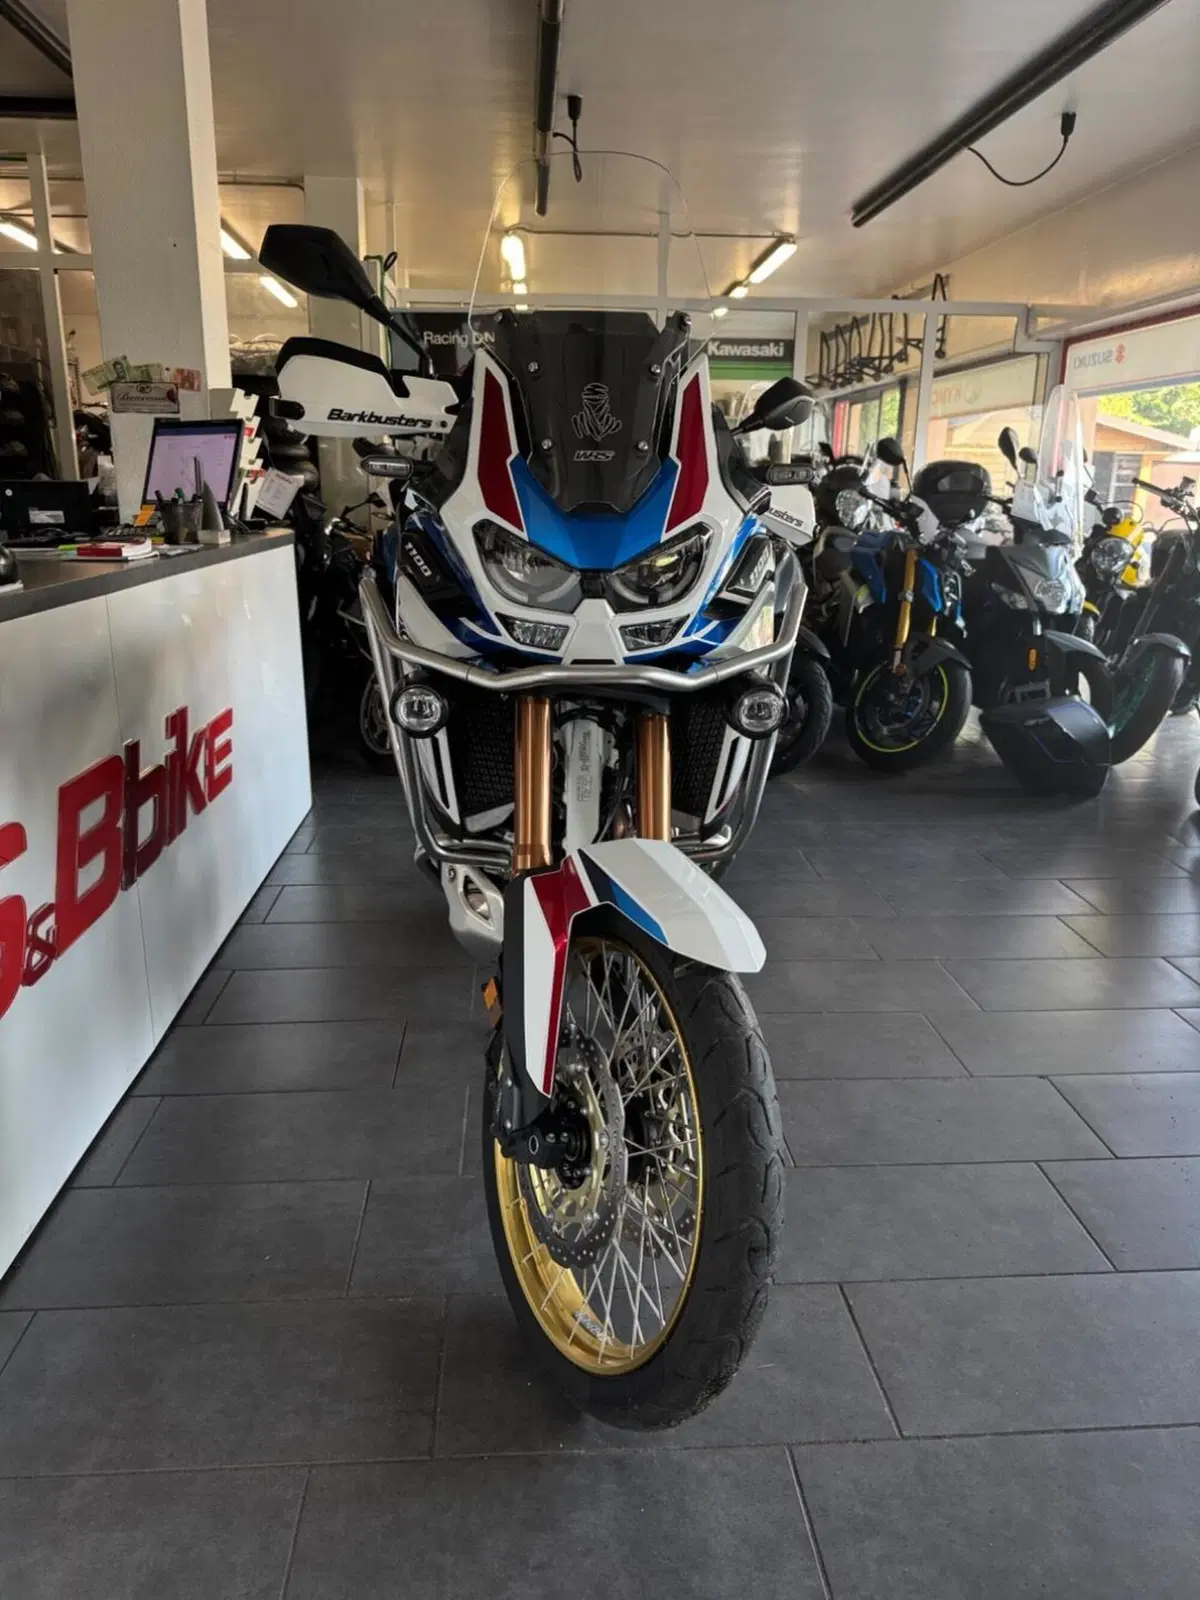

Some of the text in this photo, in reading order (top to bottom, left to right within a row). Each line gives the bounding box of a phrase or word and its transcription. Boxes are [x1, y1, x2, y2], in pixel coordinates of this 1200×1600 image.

[423, 331, 469, 348] Racing
[708, 341, 785, 357] Kawasaki
[327, 408, 433, 429] Barkbusters
[768, 508, 804, 527] usters
[405, 541, 432, 577] 1100
